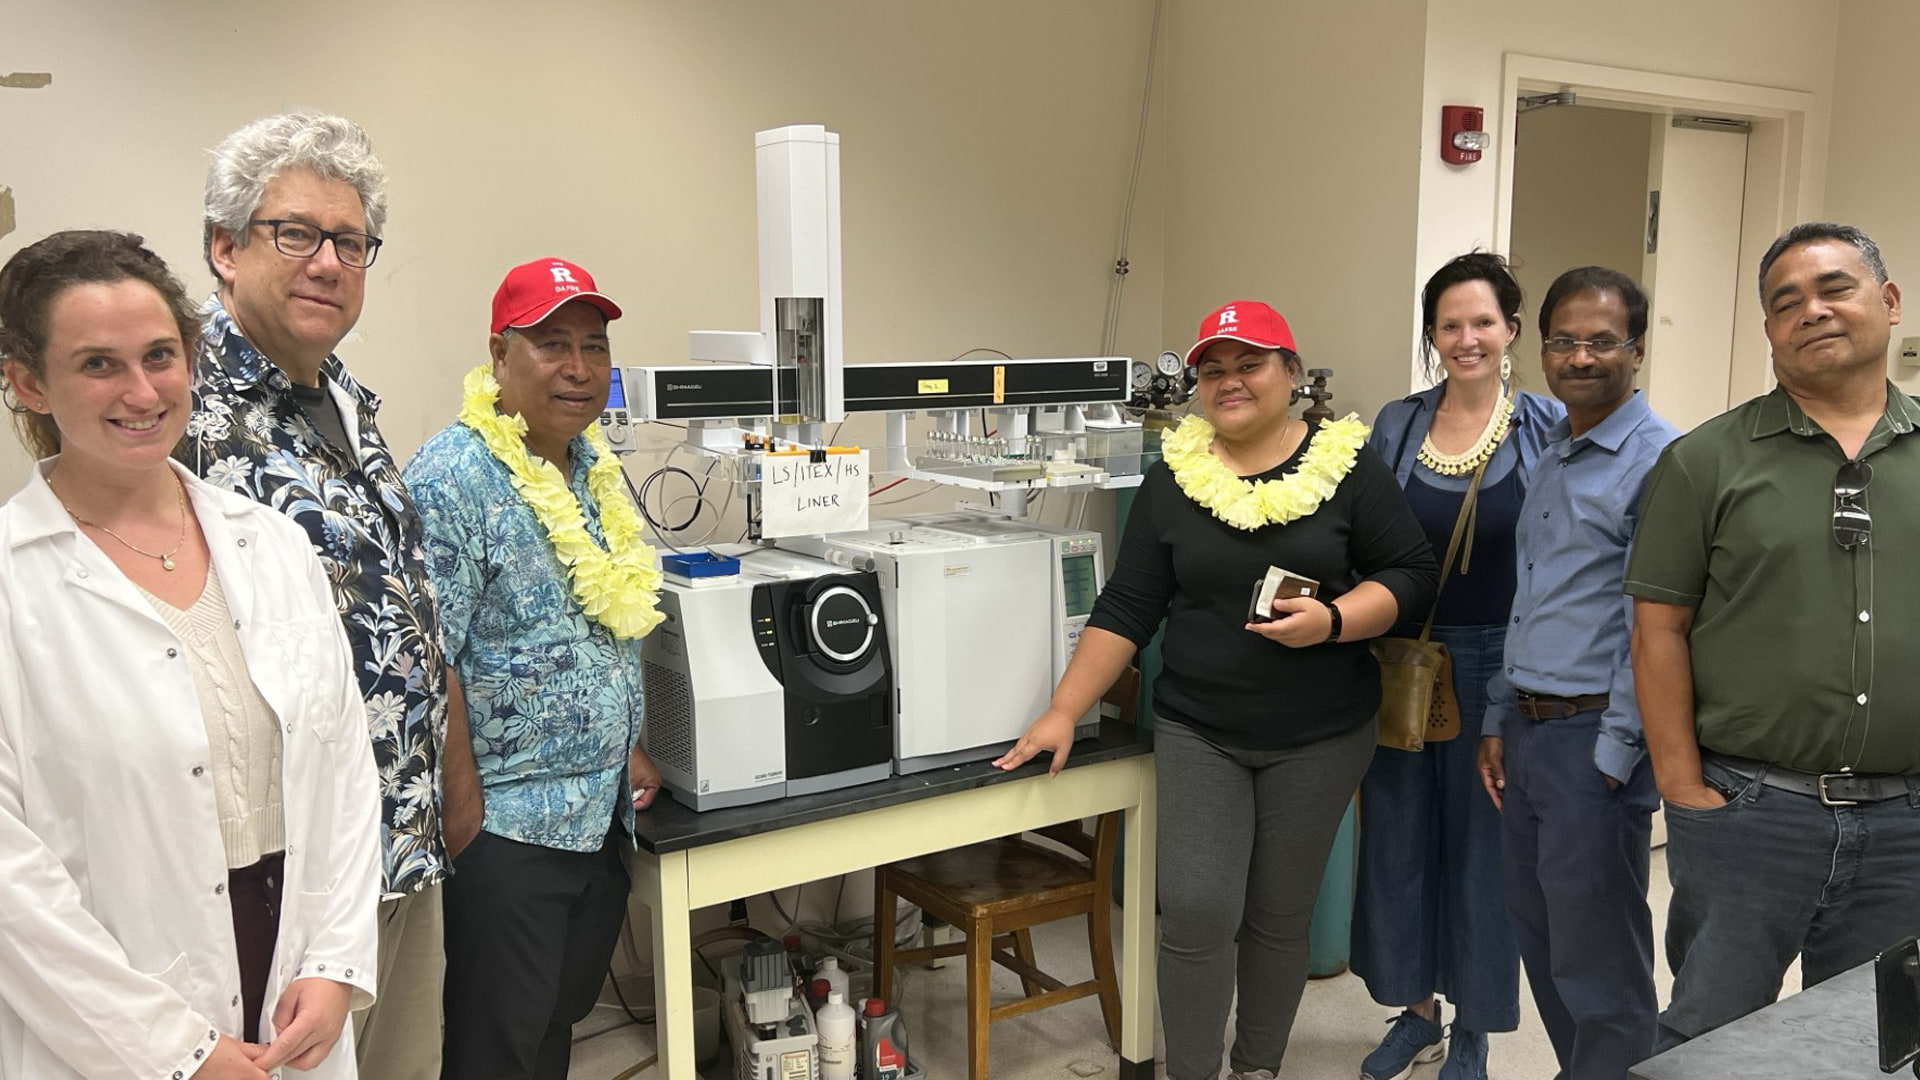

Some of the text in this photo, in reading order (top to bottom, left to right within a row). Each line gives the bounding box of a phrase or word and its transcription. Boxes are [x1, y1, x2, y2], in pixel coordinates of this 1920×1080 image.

[1460, 152, 1477, 161] FIRE
[550, 267, 578, 283] R
[1219, 310, 1240, 326] R
[797, 494, 841, 512] LINER
